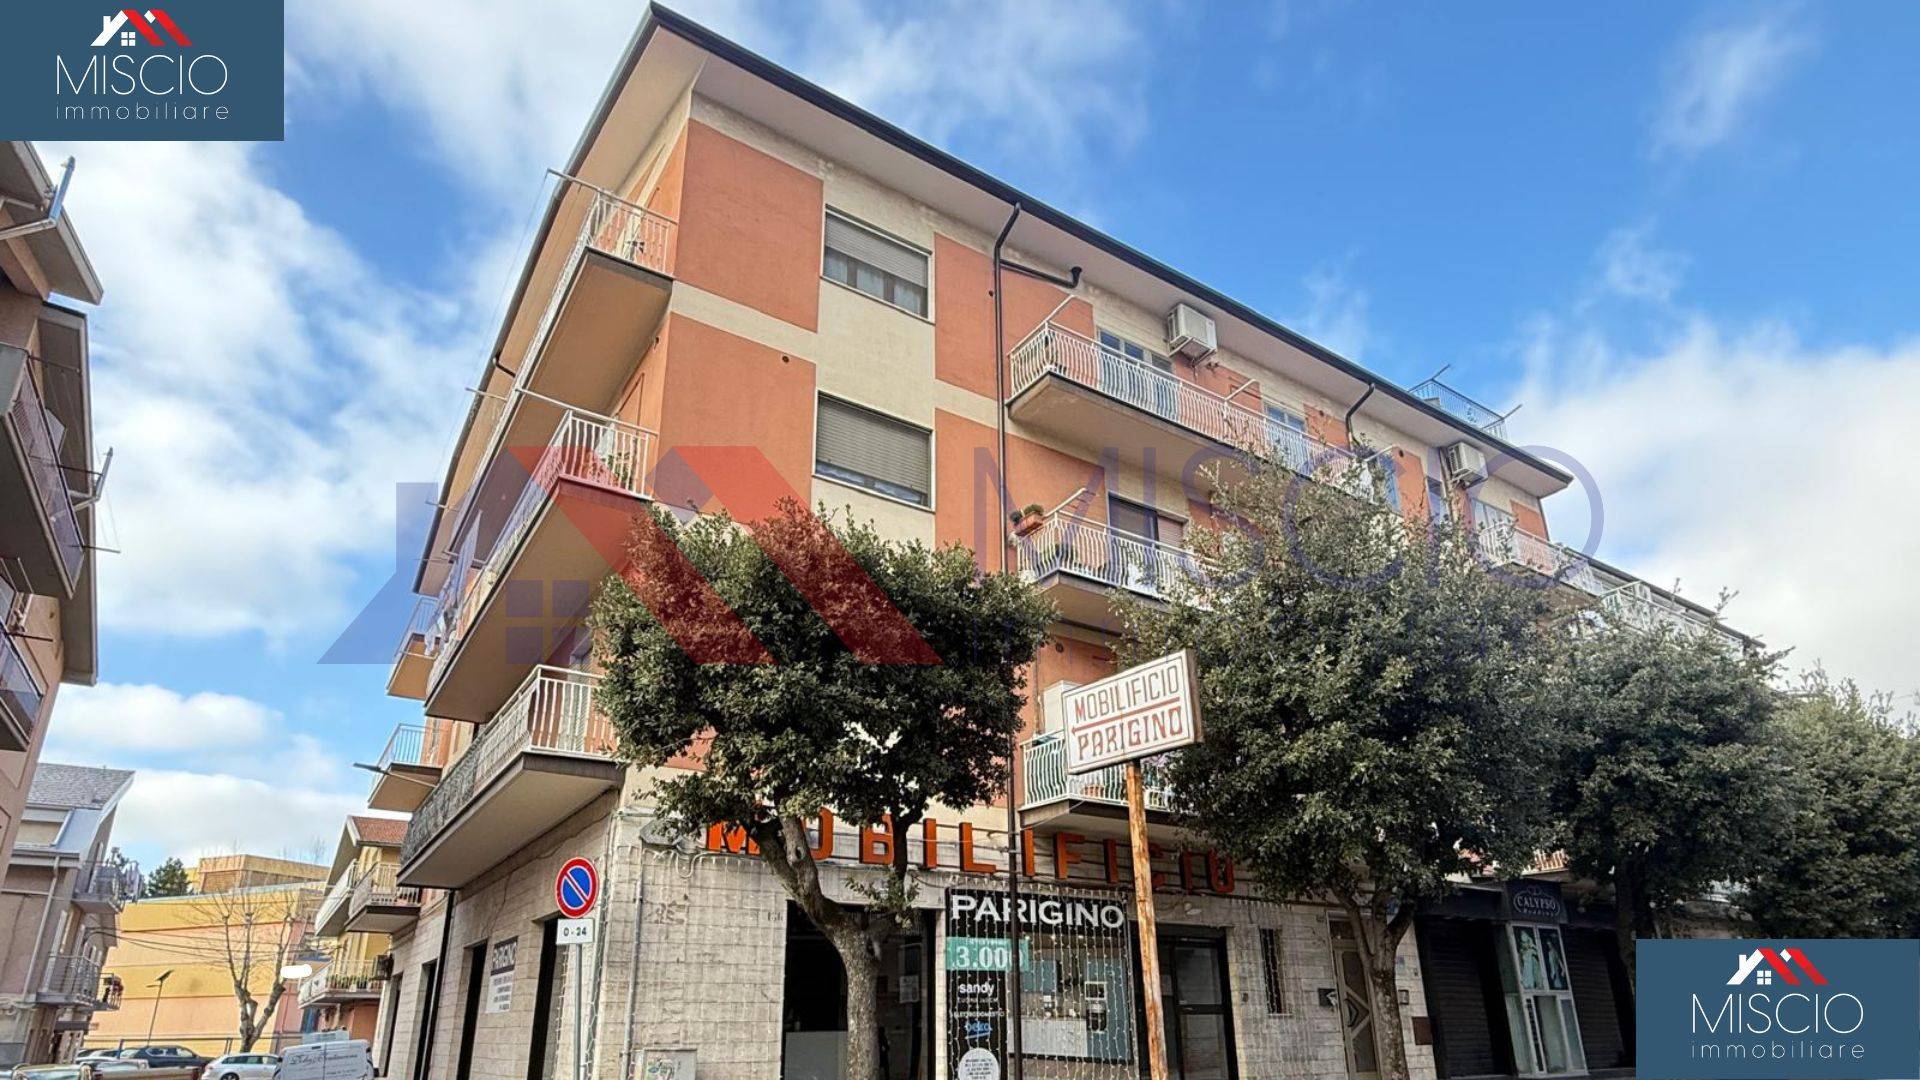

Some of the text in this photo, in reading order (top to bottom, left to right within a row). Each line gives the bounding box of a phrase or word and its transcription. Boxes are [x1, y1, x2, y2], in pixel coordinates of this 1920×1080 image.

[1073, 665, 1180, 724] MOBILIFICIO
[1077, 706, 1183, 761] PARIGINO
[951, 894, 1125, 929] PARIGINO
[1517, 895, 1556, 911] CALYPSO
[959, 981, 995, 996] sandy
